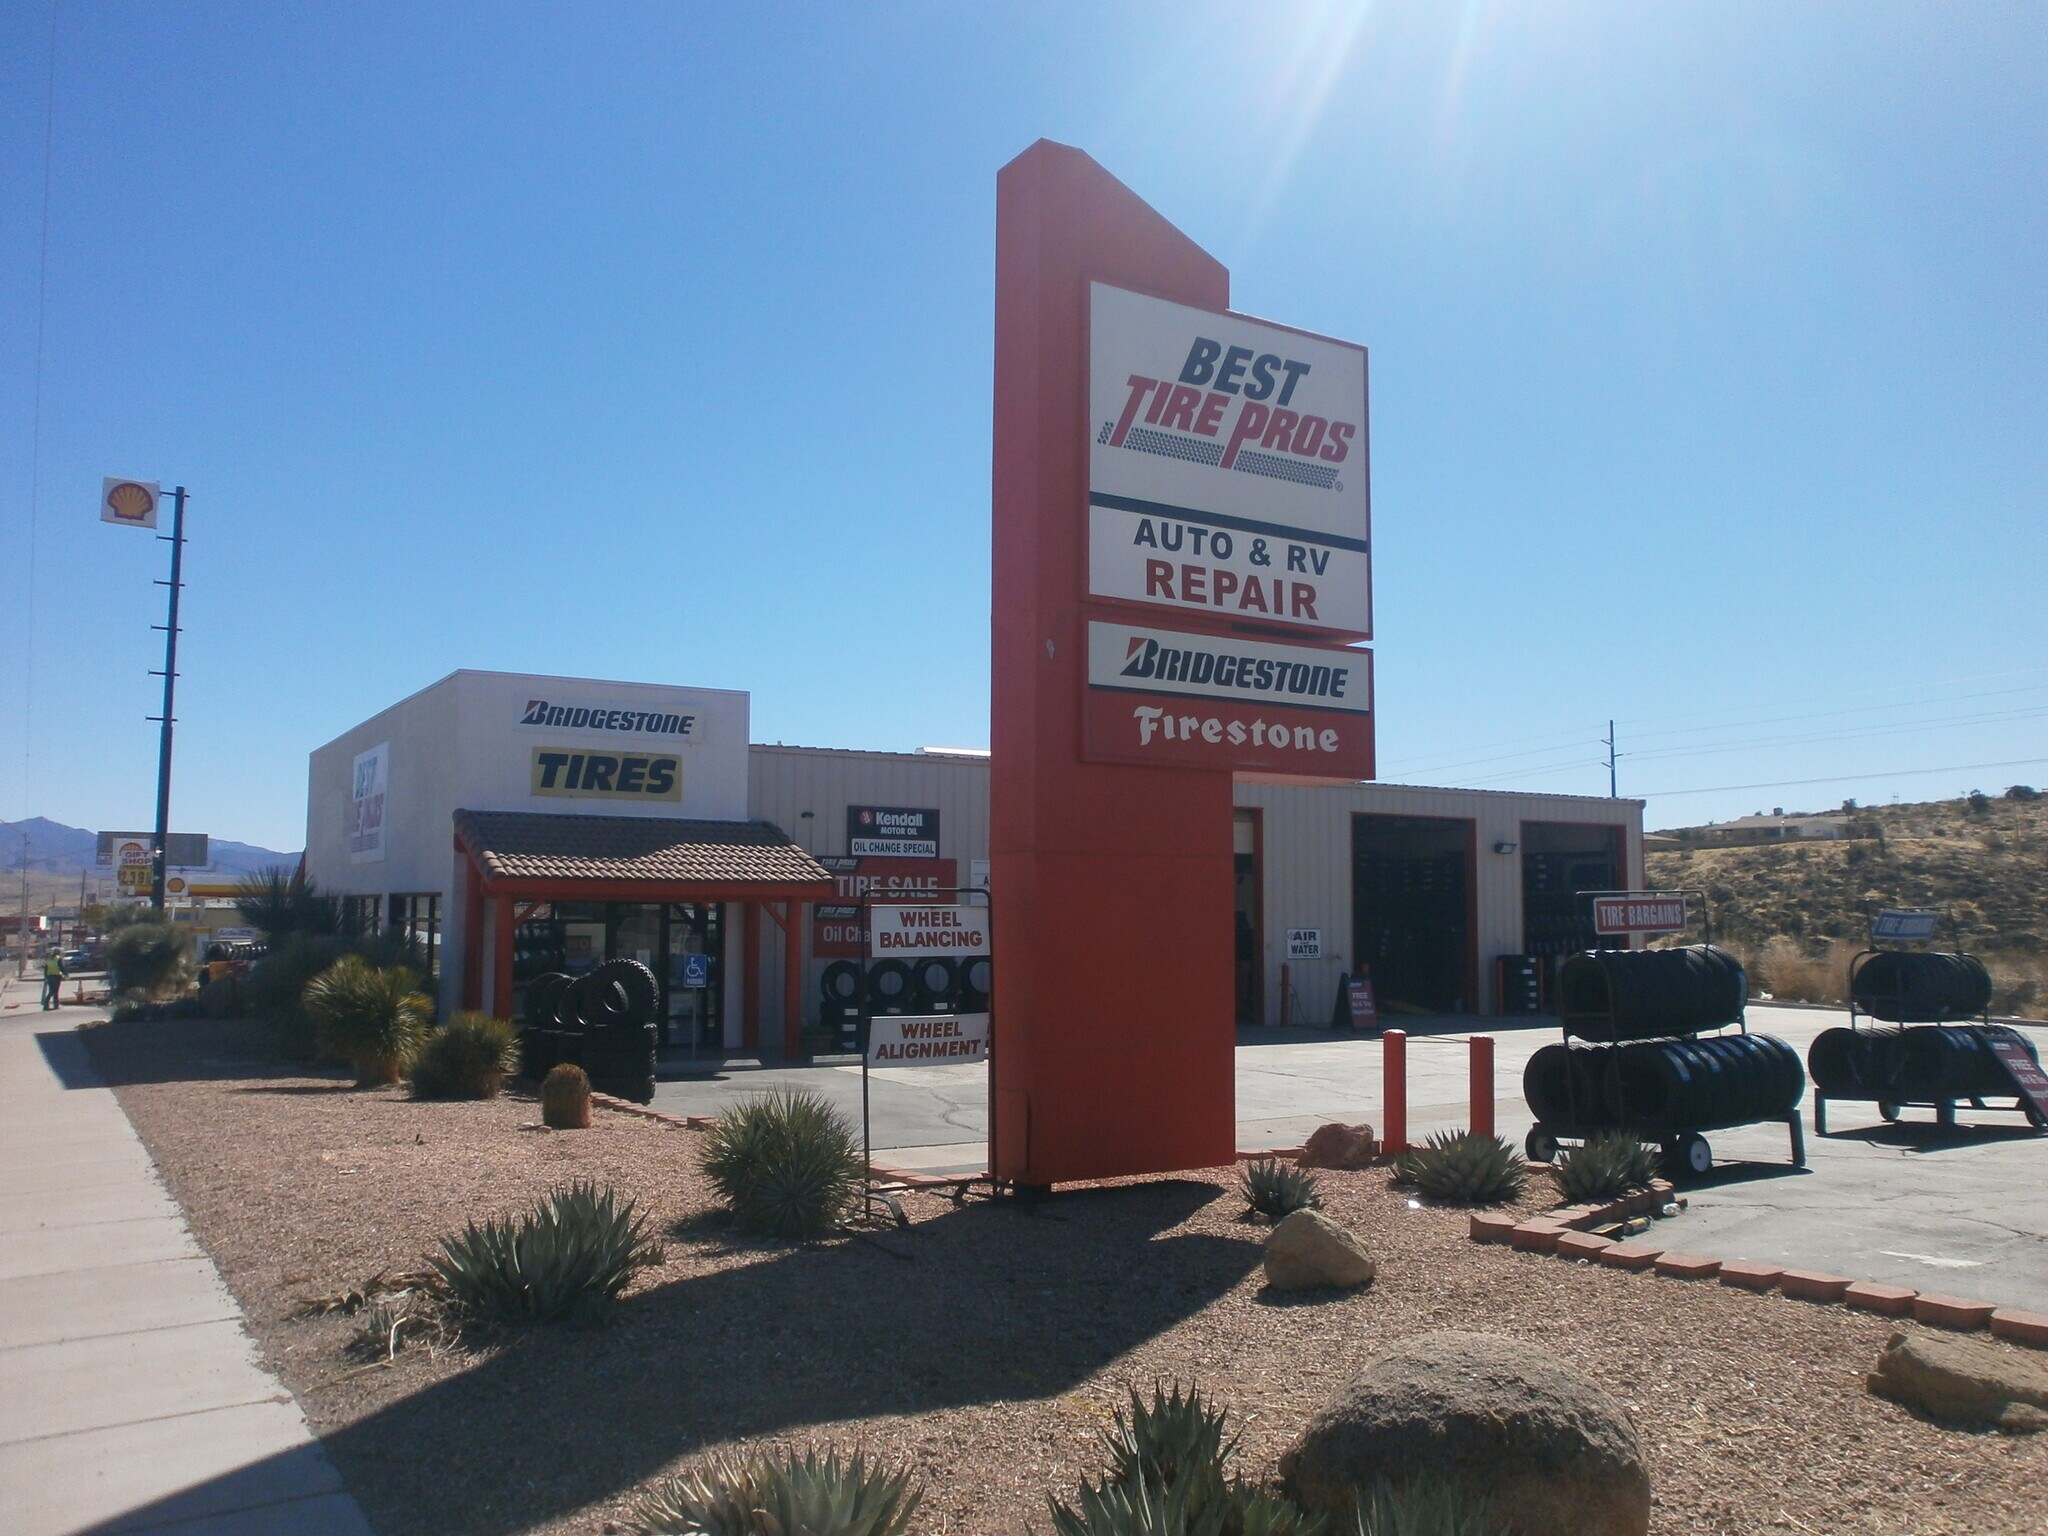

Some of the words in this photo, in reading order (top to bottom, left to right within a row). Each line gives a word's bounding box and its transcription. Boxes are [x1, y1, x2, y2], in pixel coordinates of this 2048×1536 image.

[1178, 336, 1312, 406] BEST
[1108, 374, 1231, 448] TIRE
[1219, 401, 1356, 470] PROS
[1133, 518, 1234, 560] AUTO
[1249, 538, 1271, 568] &
[1287, 543, 1331, 576] RV
[1146, 558, 1319, 621] REPAIR
[1119, 636, 1349, 698] BRIDGESTONE
[520, 700, 695, 735] BRIDGESTONE
[1133, 705, 1339, 752] Firestone
[538, 753, 677, 794] TIRES
[875, 812, 923, 826] Kendall
[880, 827, 906, 835] MOTOR
[907, 828, 918, 836] OIL
[853, 842, 867, 852] OIL
[869, 842, 901, 853] CHANGE
[903, 843, 935, 854] SPECIAL
[835, 875, 882, 897] TIRE
[887, 876, 938, 898] SALE
[900, 911, 962, 927] WHEEL
[1600, 905, 1625, 926] TIRE
[1628, 904, 1682, 926] BARGAINS
[823, 925, 842, 942] Oil
[845, 926, 871, 943] Cha
[879, 930, 983, 948] BALANCING
[1293, 931, 1317, 941] AIR
[1290, 944, 1319, 954] WATER
[901, 1021, 963, 1039] WHEEL
[875, 1039, 981, 1060] ALIGNMENT
